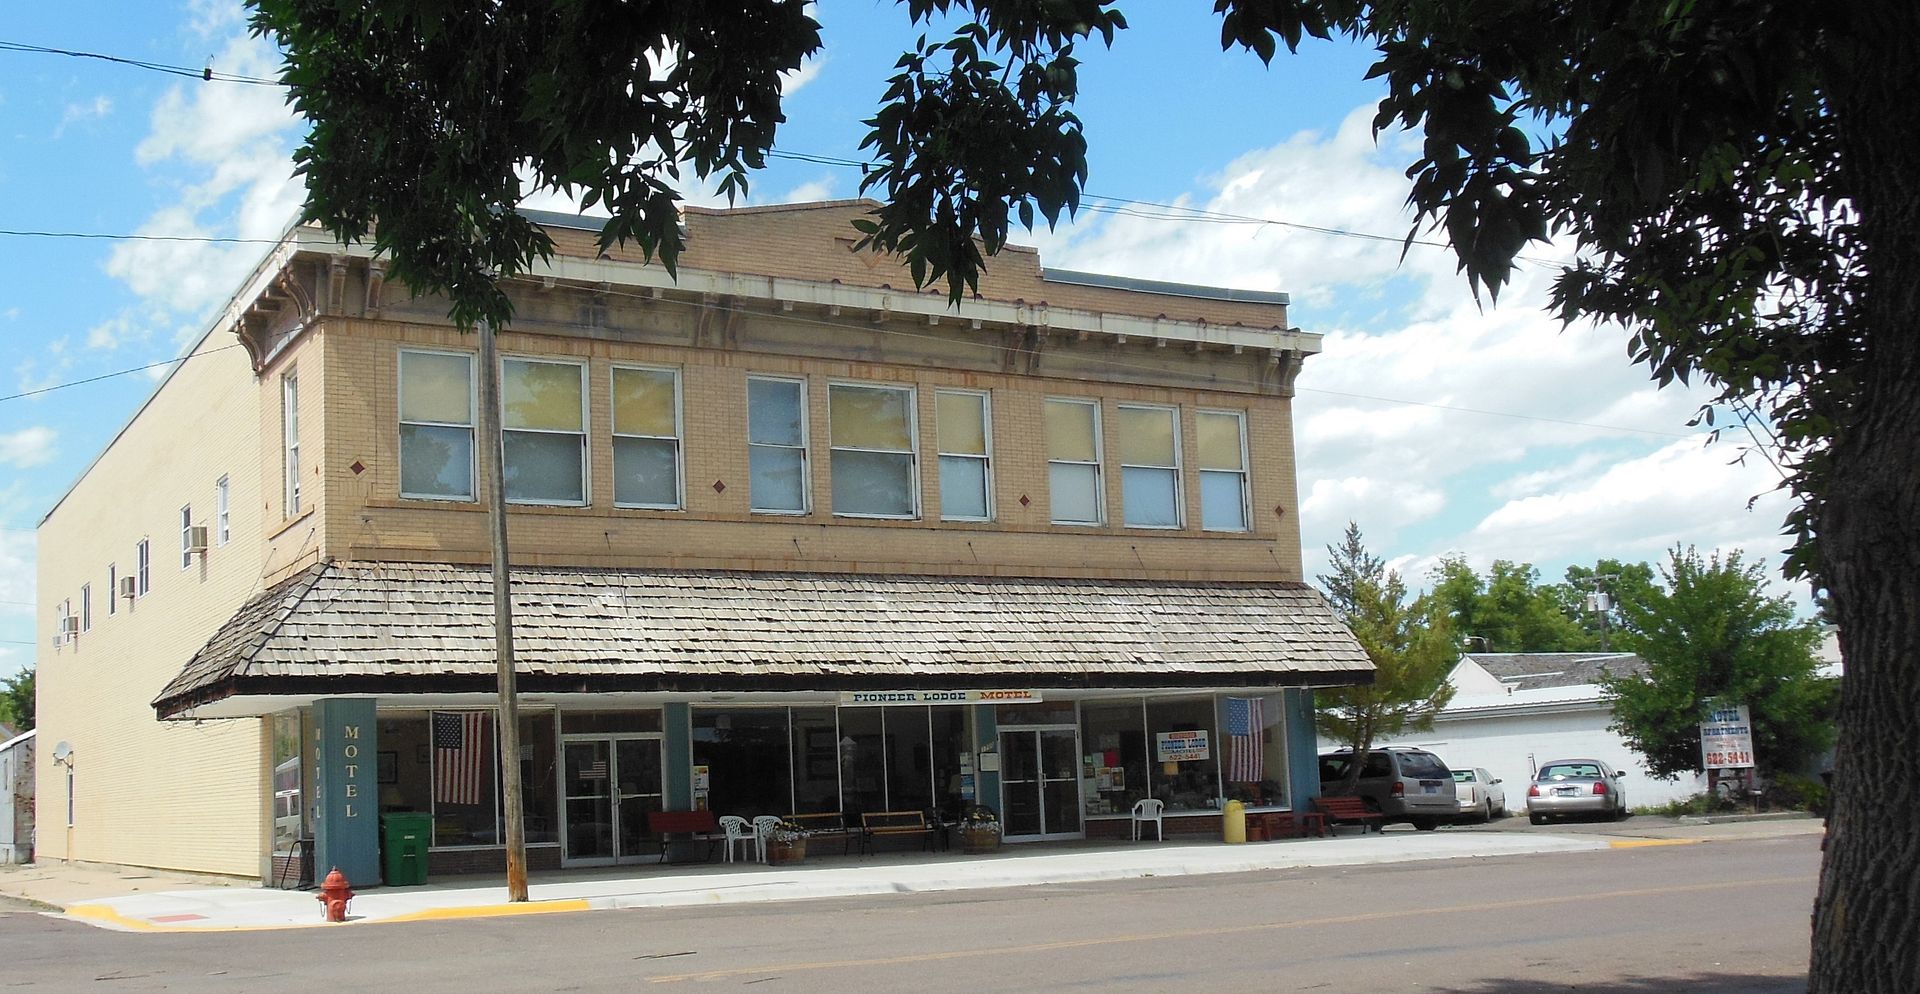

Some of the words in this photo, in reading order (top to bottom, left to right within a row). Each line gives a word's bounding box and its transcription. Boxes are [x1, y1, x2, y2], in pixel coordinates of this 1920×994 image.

[854, 694, 916, 702] PIONEER
[980, 691, 1032, 699] MOTEL
[1703, 726, 1748, 736] APARTMENTS
[1706, 752, 1750, 764] 622-5441
[344, 726, 360, 818] MOTEL
